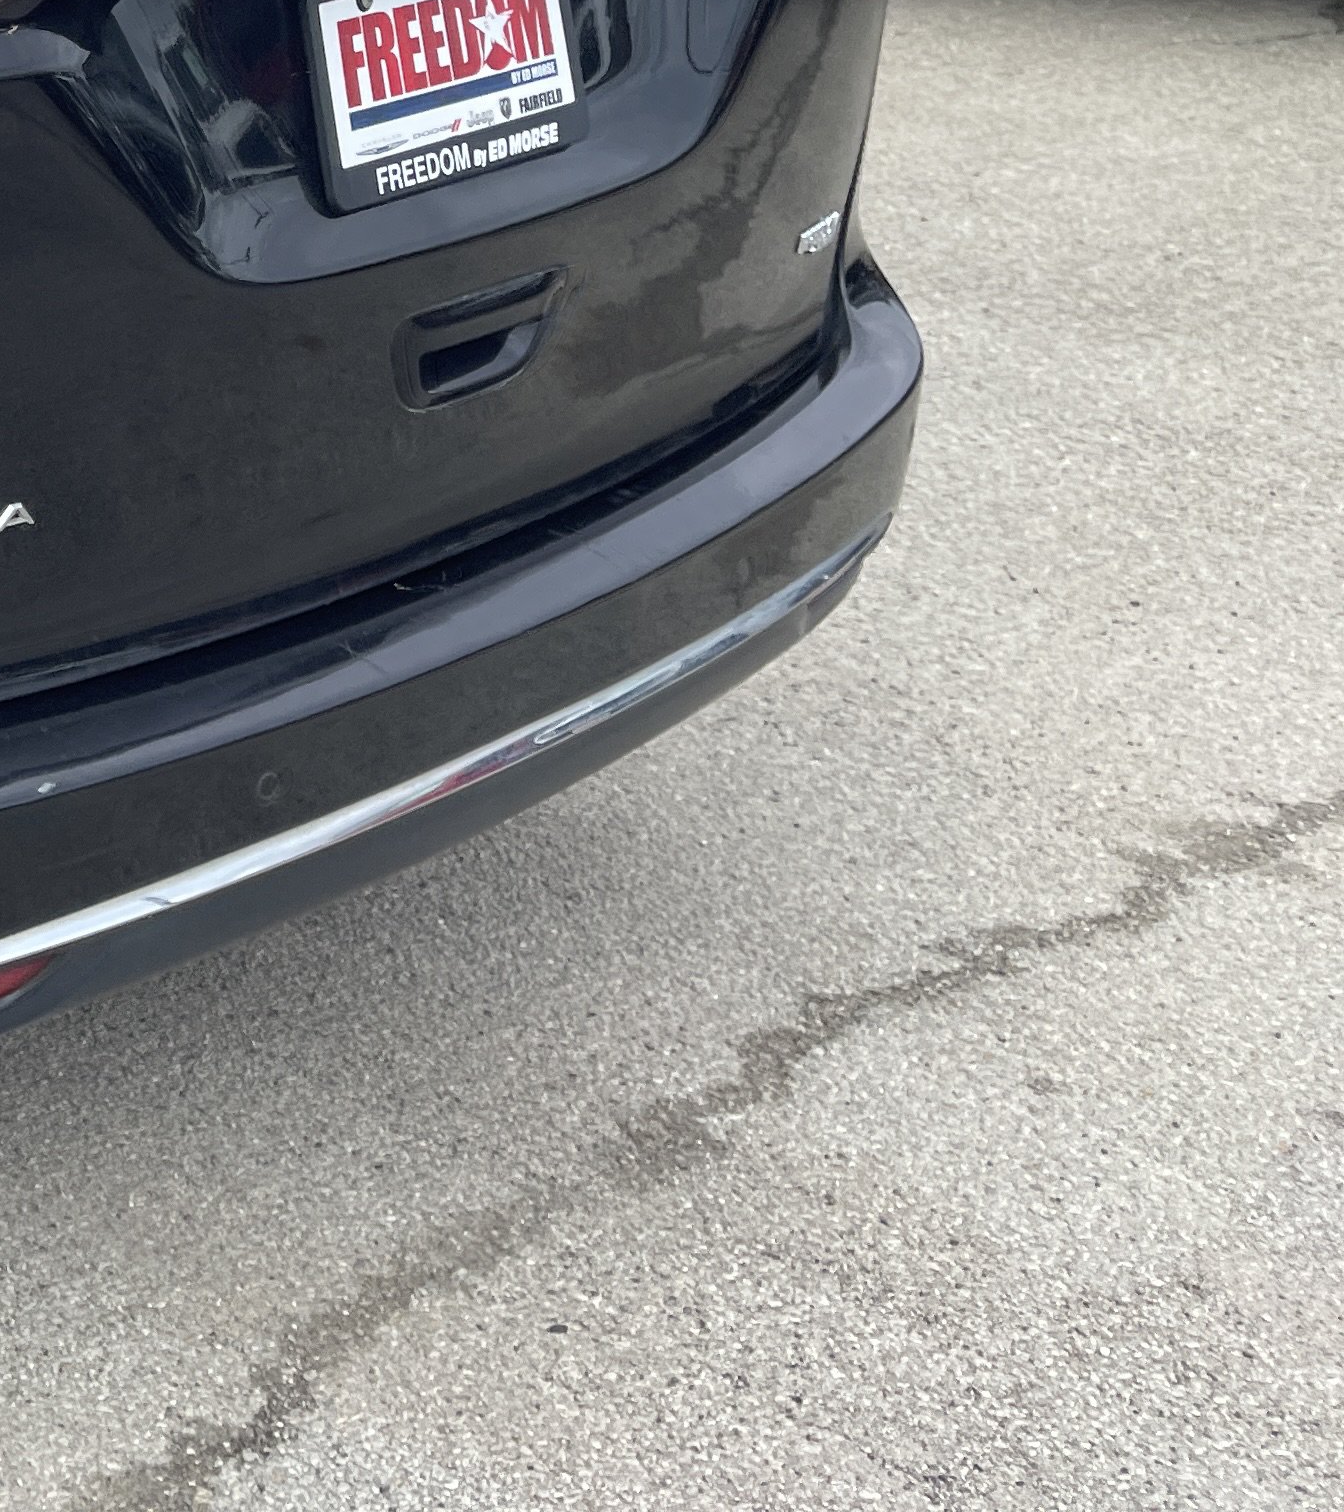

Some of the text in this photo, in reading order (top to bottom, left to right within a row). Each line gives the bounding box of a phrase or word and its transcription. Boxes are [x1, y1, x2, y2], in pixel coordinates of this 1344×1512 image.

[519, 88, 563, 114] FAIRFIELD
[376, 142, 471, 195] FREEDOM
[488, 138, 508, 162] ED
[508, 122, 559, 156] MORSE
